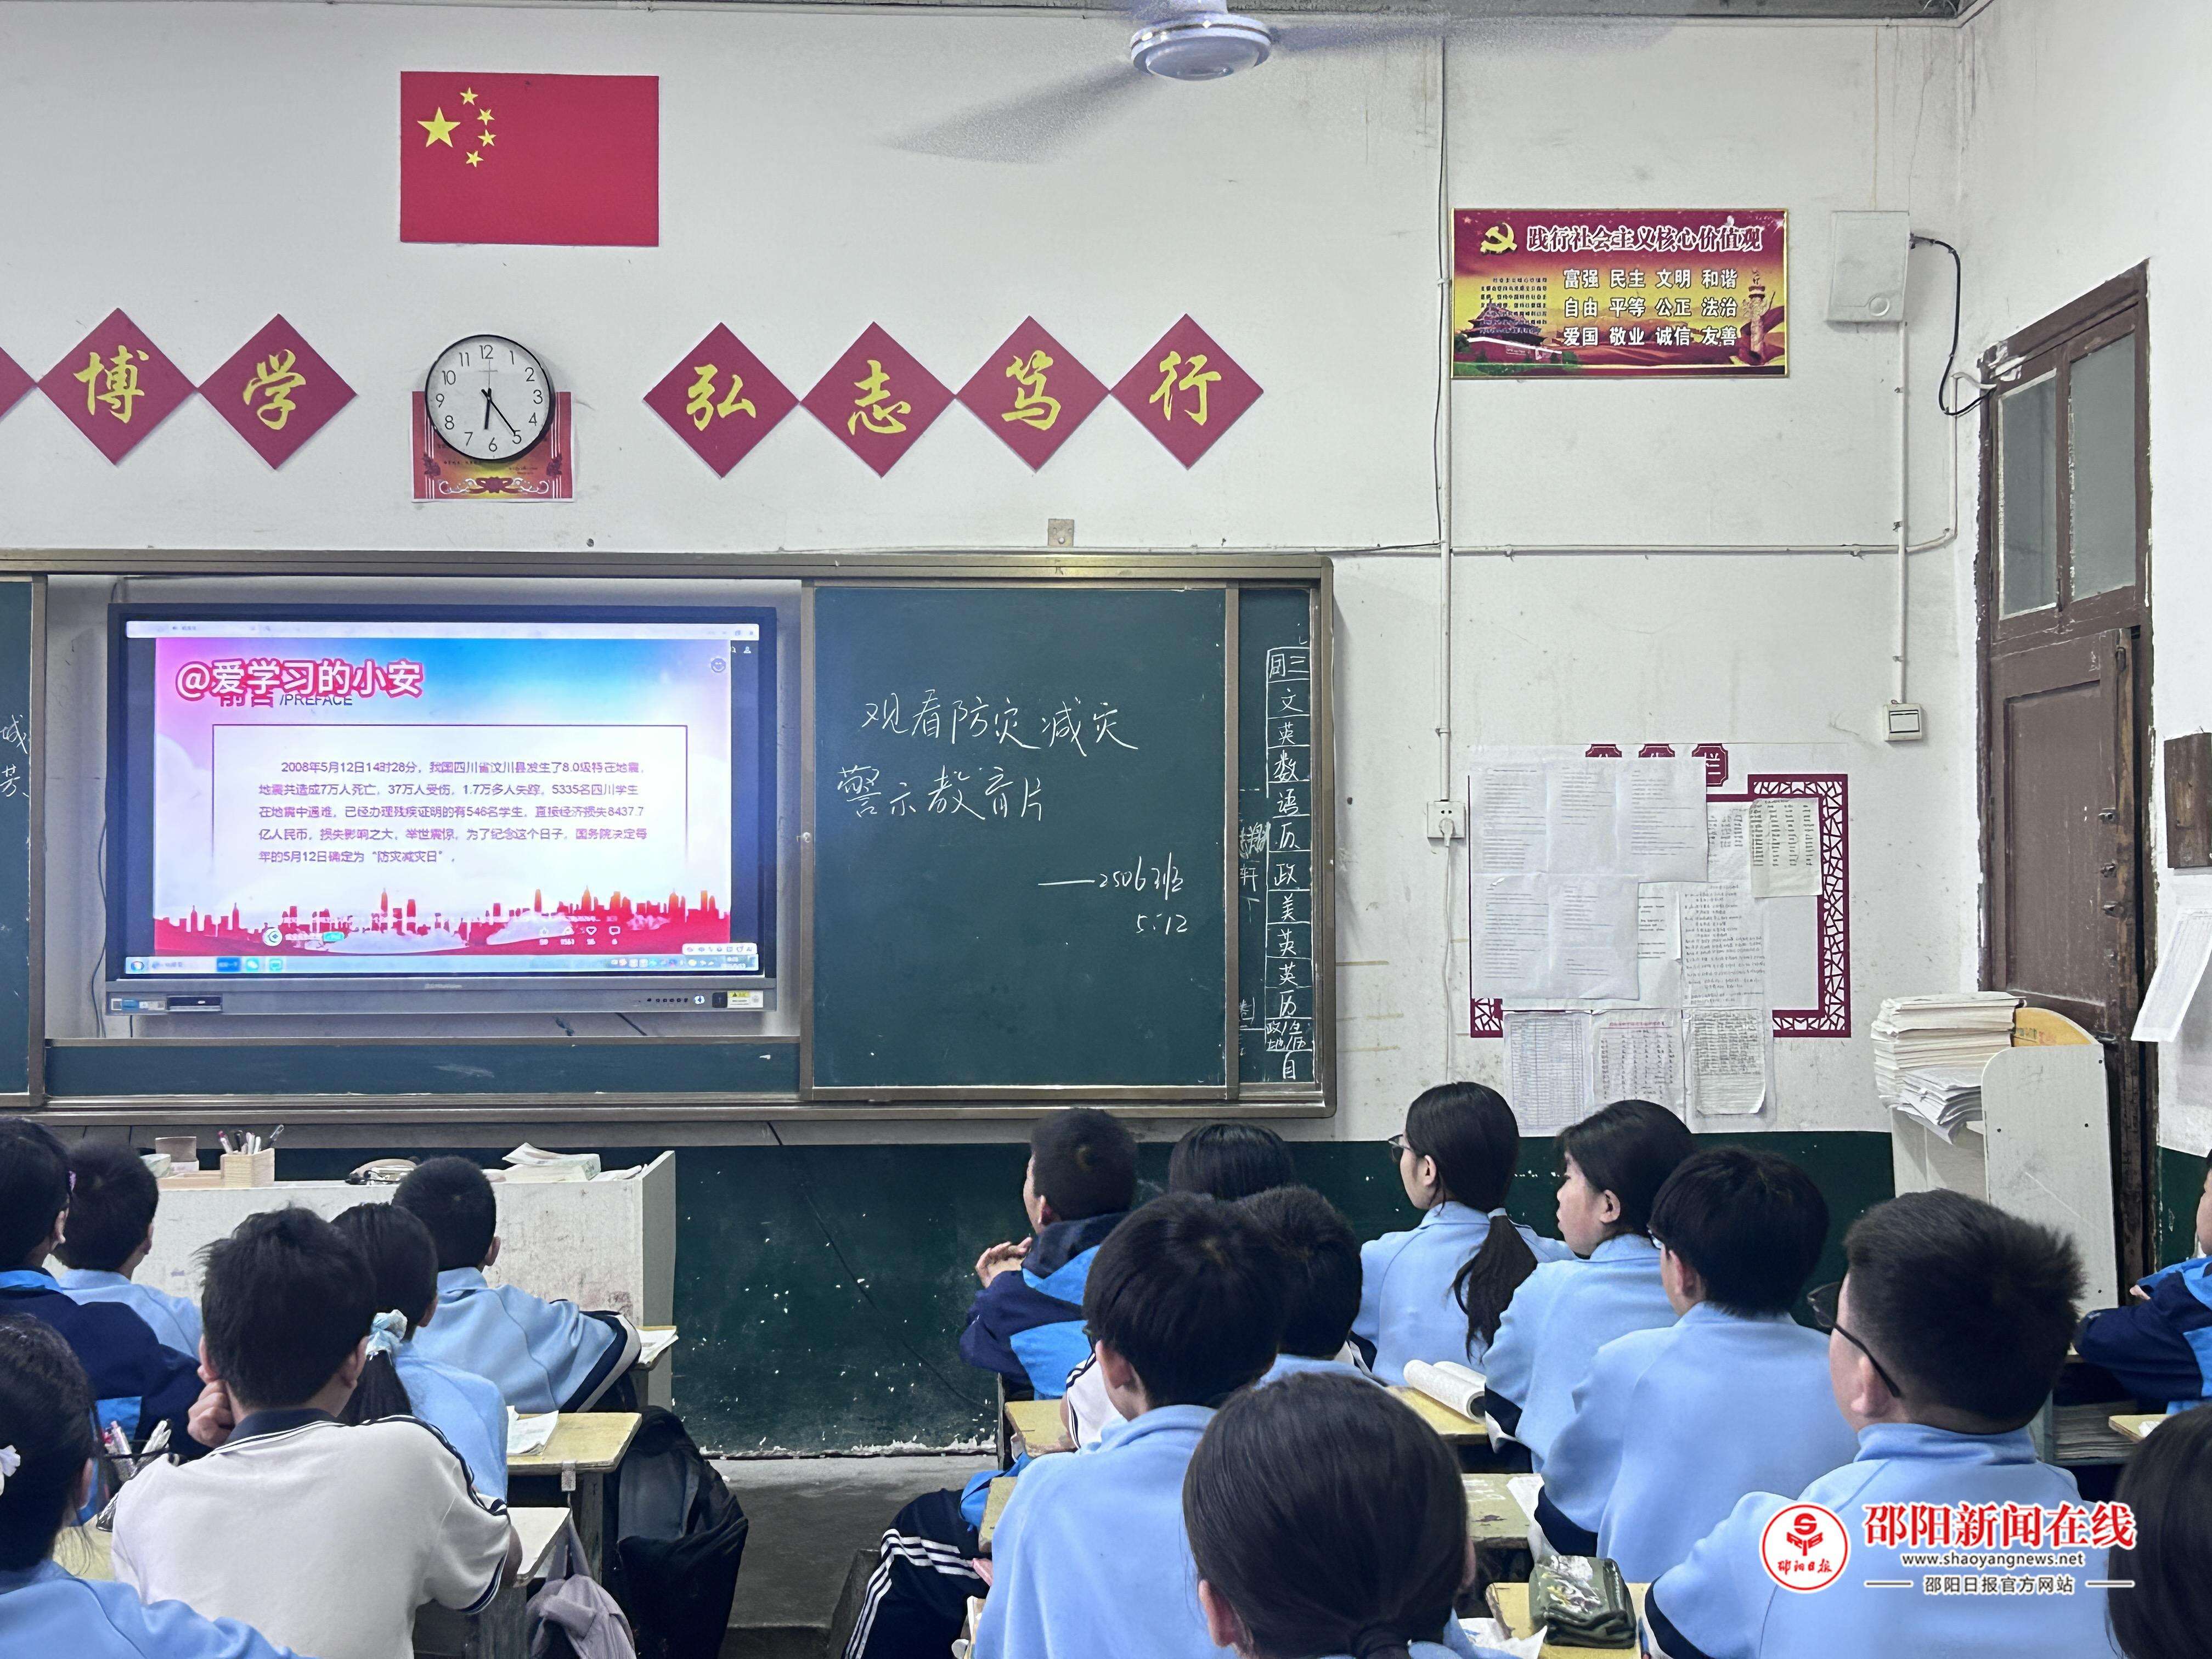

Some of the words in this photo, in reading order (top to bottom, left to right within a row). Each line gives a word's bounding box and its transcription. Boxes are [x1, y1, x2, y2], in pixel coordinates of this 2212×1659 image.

[1527, 224, 1763, 252] 践行社会主义核心价值观
[1563, 269, 1599, 289] 富强
[1610, 269, 1645, 289] 民主
[1655, 269, 1691, 289] 文明
[1702, 269, 1738, 289] 和谐
[1564, 297, 1598, 318] 自由
[1609, 297, 1646, 318] 平等
[1655, 298, 1691, 317] 公正
[1702, 298, 1737, 317] 法治
[1563, 327, 1599, 346] 爱国
[1609, 327, 1645, 346] 敬业
[1655, 327, 1691, 346] 诚信
[1702, 326, 1737, 347] 友善
[459, 352, 470, 367] 11
[479, 345, 494, 359] 12
[442, 370, 456, 385] 10
[524, 367, 535, 382] 2
[436, 393, 445, 408] 9
[533, 390, 543, 404] 3
[444, 415, 455, 430] 8
[528, 412, 537, 426] 4
[464, 432, 473, 446] 7
[488, 437, 498, 452] 6
[512, 430, 522, 444] 5
[176, 658, 423, 701] @爱学习的小安
[861, 689, 1138, 757] 观看防灾减灾
[837, 765, 1042, 821] 警示教育片
[1274, 864, 1296, 886] 政
